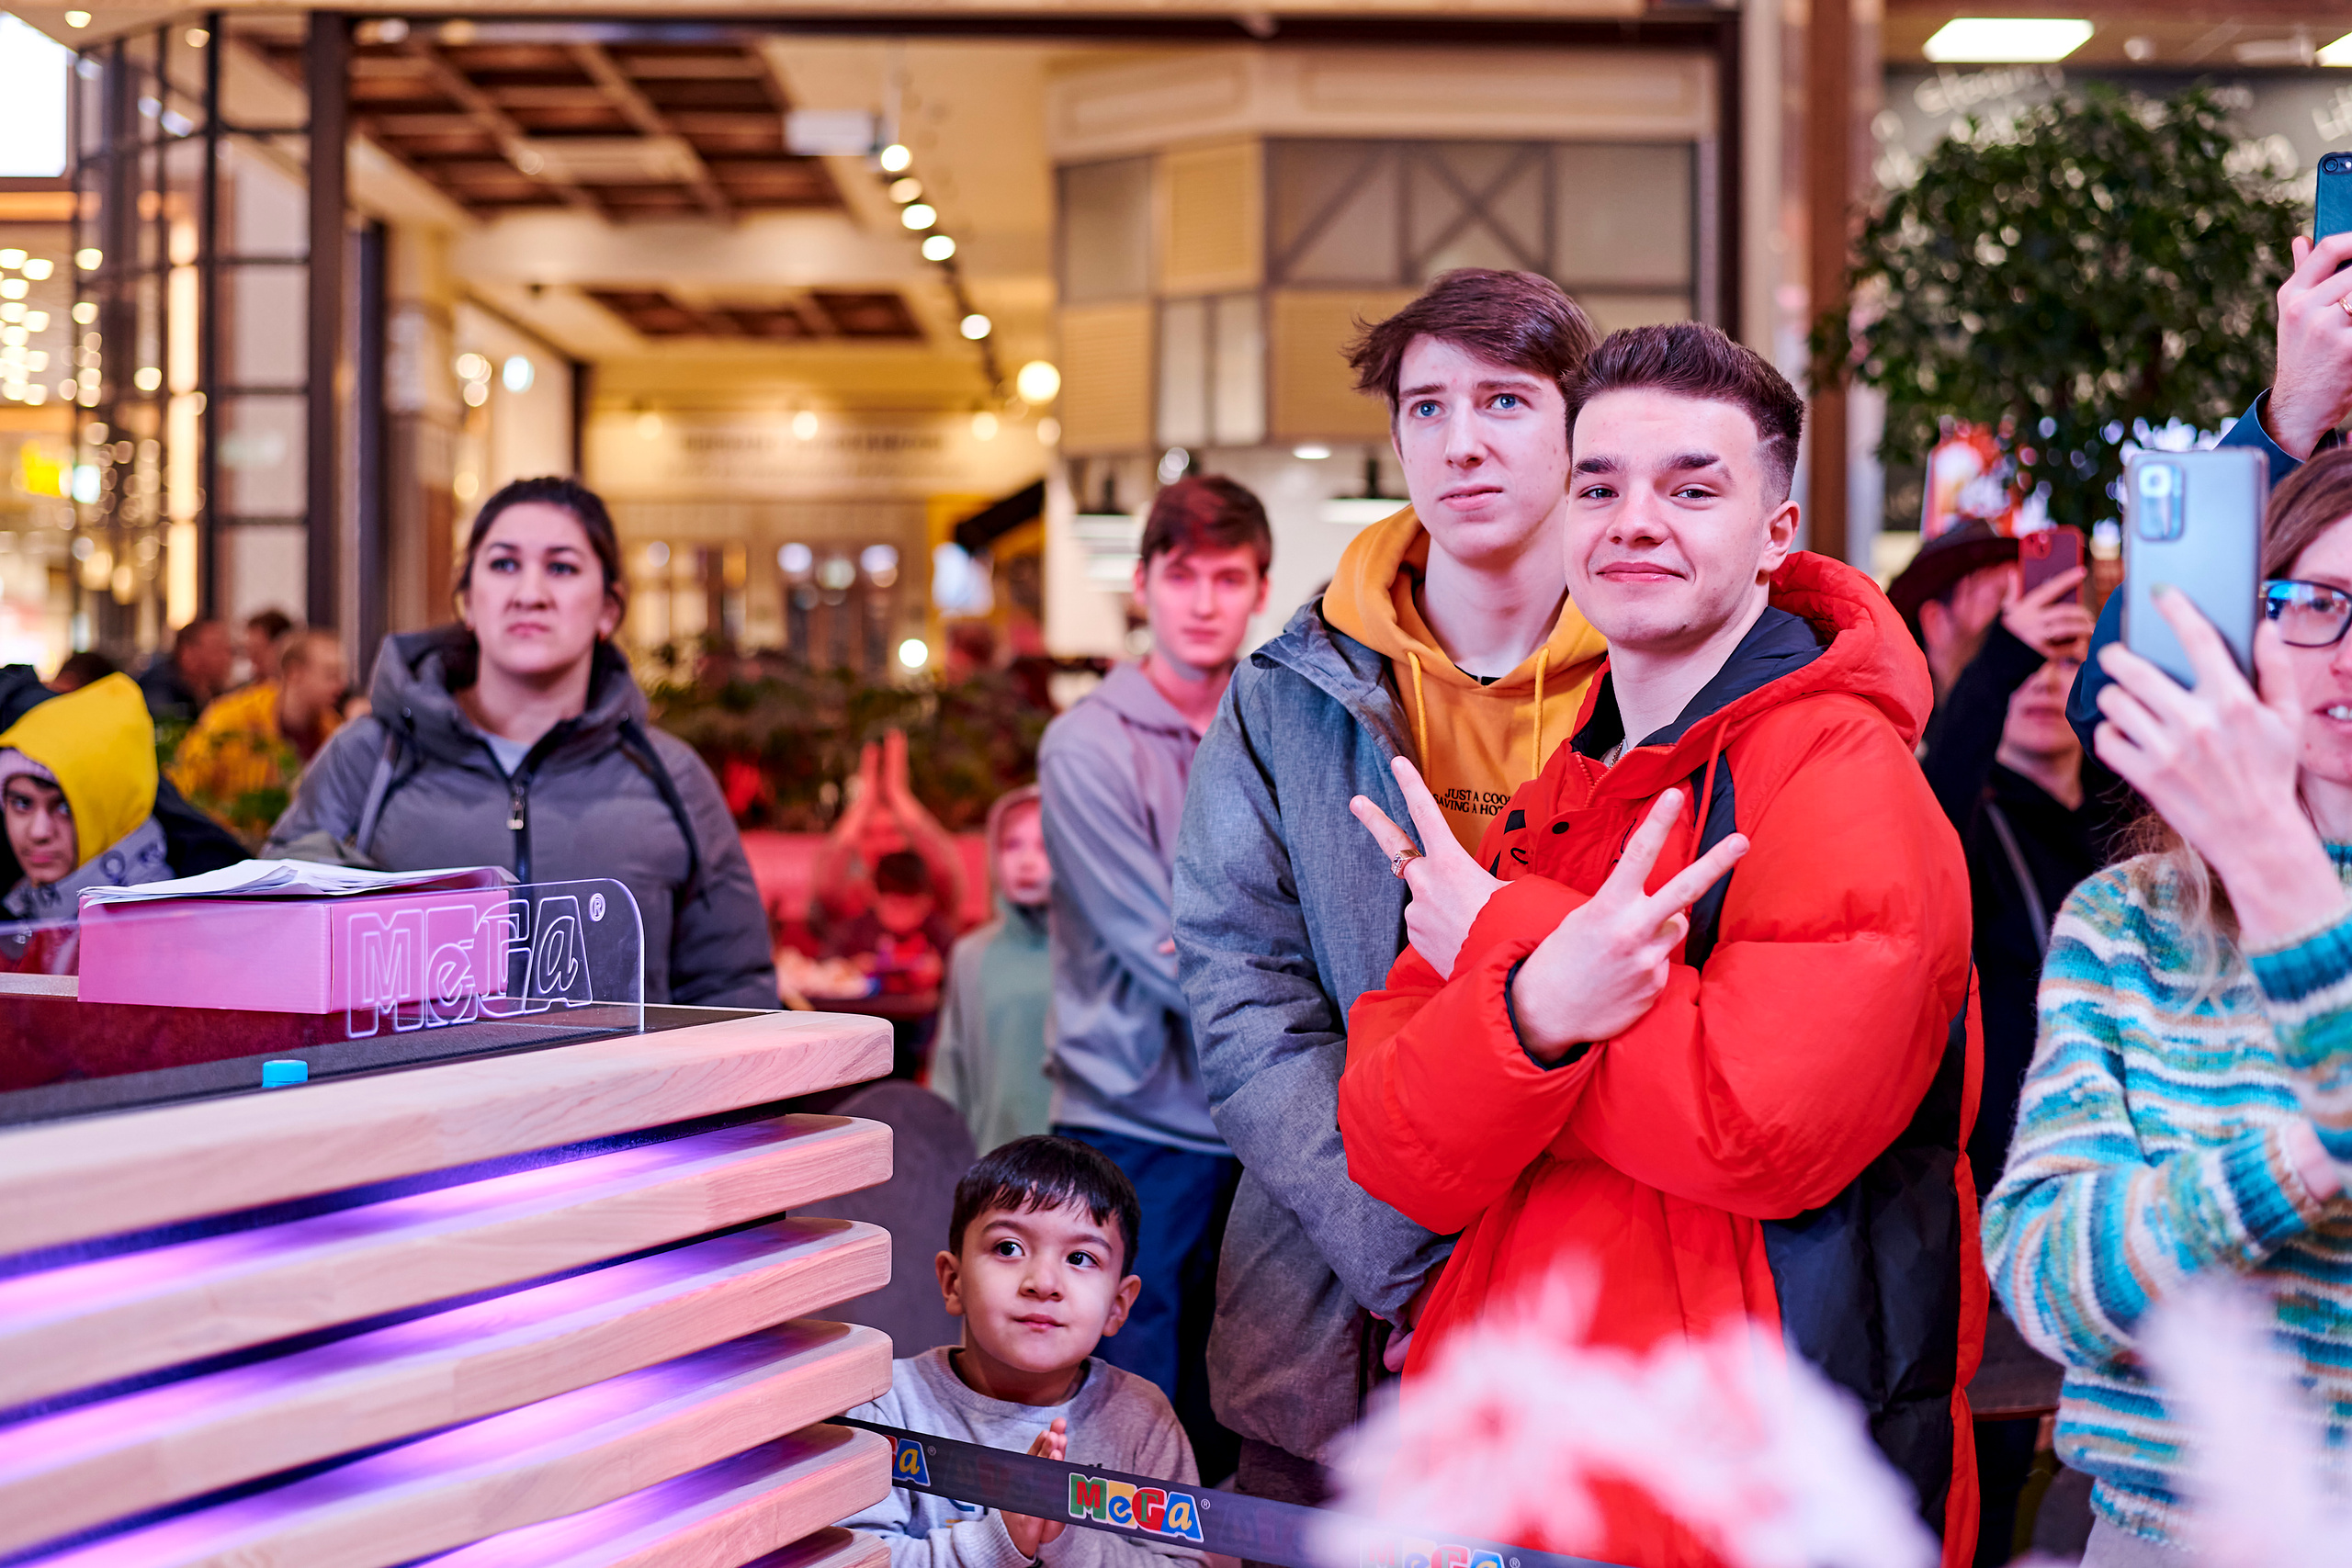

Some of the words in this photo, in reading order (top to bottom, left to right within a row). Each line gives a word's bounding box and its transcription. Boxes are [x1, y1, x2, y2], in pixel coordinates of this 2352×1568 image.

[1444, 788, 1472, 801] JUST
[1474, 791, 1479, 802] A
[1472, 804, 1477, 814] A
